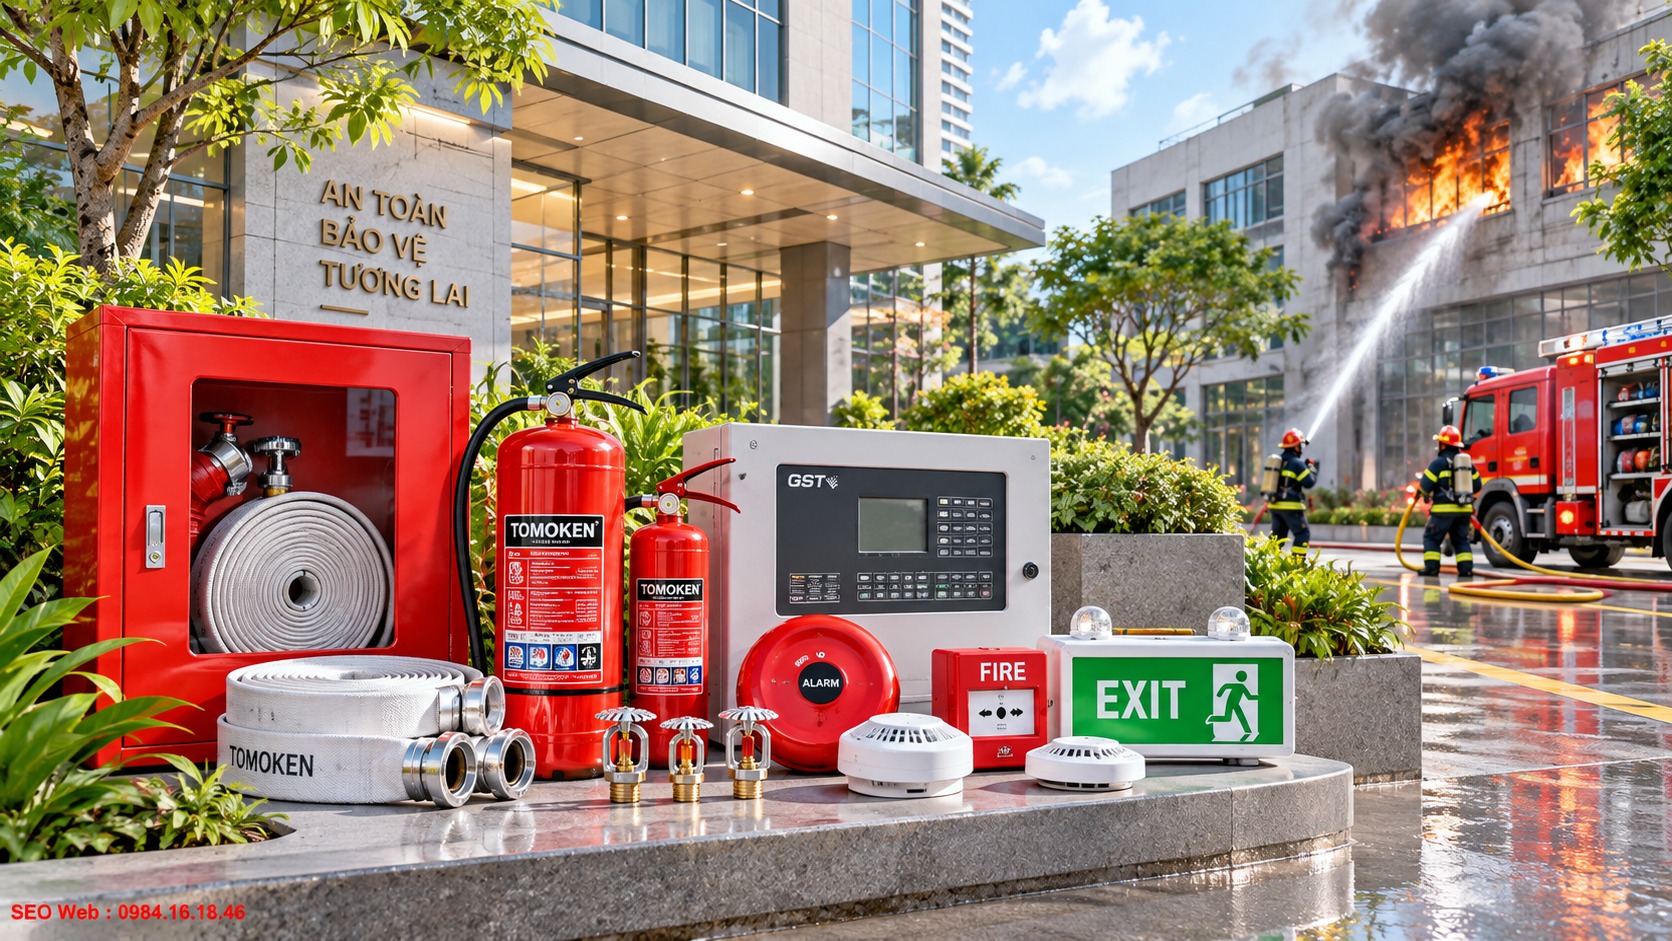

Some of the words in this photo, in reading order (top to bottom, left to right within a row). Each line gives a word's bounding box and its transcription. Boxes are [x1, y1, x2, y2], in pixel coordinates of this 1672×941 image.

[320, 179, 363, 210] AN
[372, 189, 447, 229] TOÀN
[321, 215, 384, 254] BẢO
[392, 233, 428, 268] VỆ
[319, 259, 422, 301] TƯƠNG
[431, 279, 470, 308] LAI
[788, 474, 826, 488] GST
[510, 522, 595, 538] TOMOKEN
[640, 584, 700, 595] TOMOKEN
[802, 678, 840, 688] ALARM
[980, 661, 1026, 682] FIRE
[1096, 680, 1186, 719] EXIT
[229, 745, 314, 777] TOMOKEN
